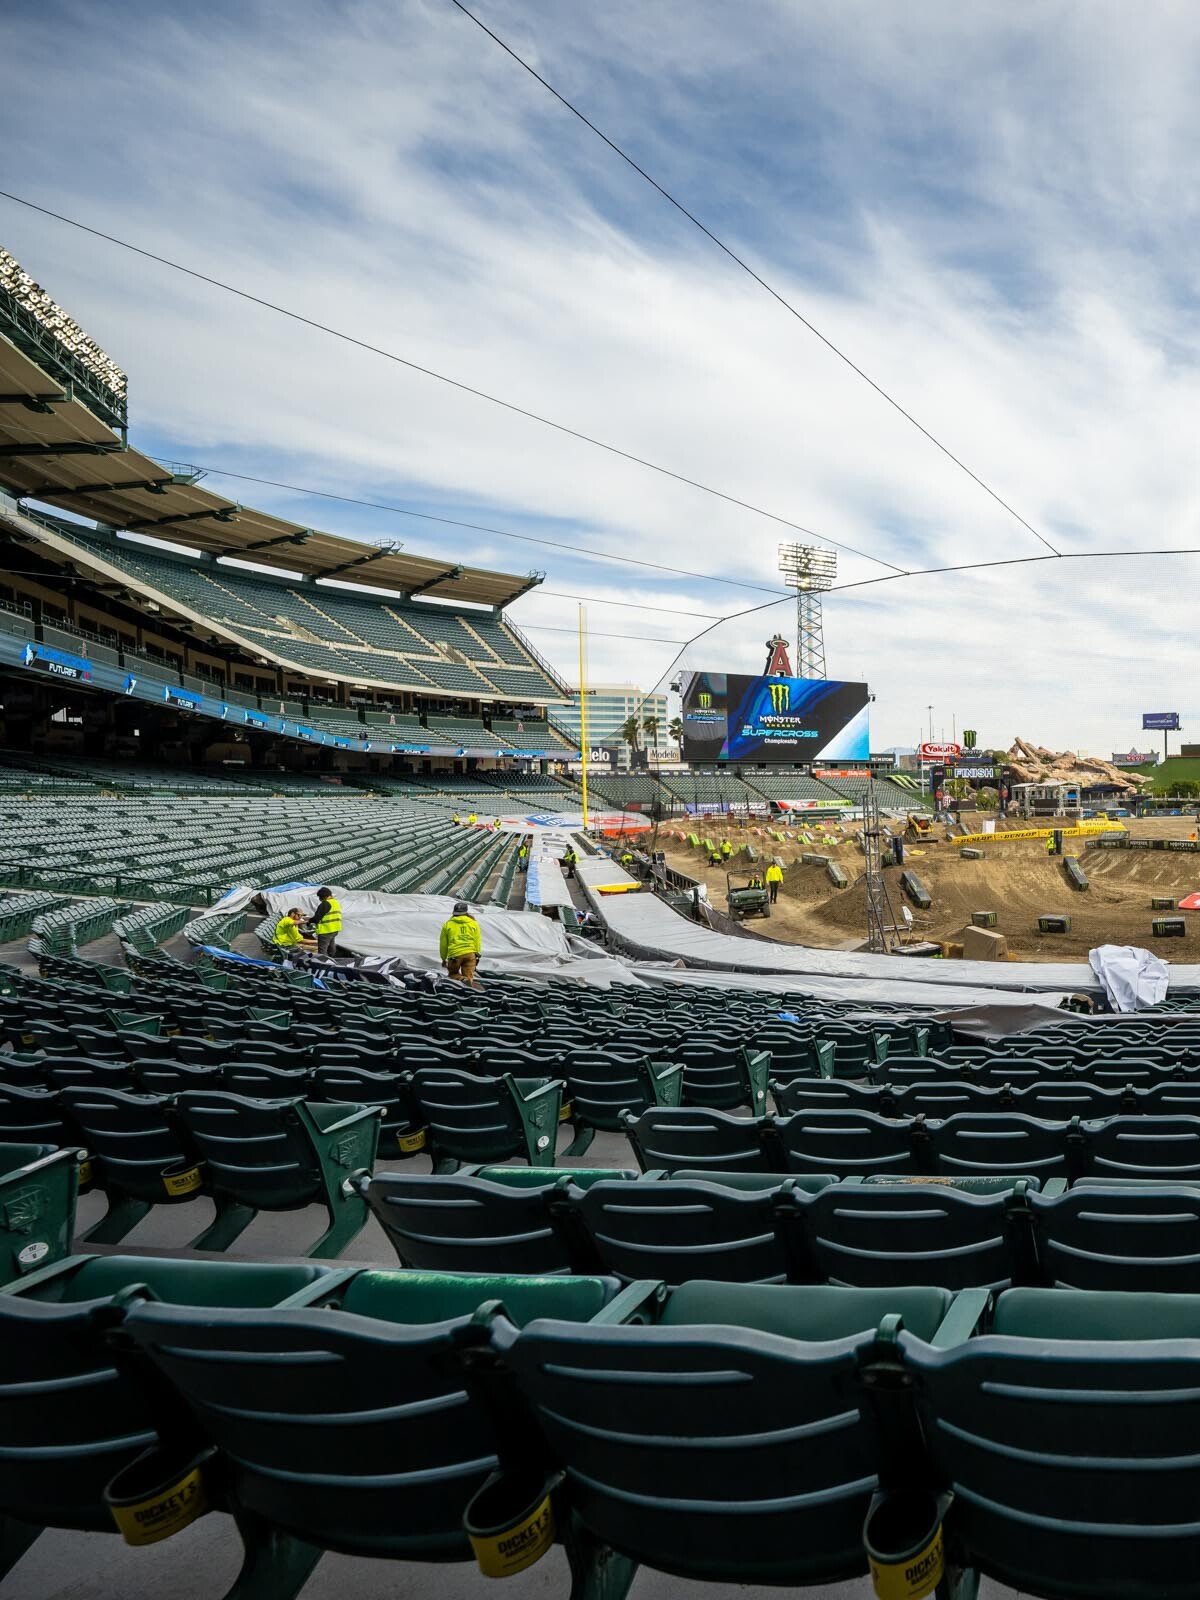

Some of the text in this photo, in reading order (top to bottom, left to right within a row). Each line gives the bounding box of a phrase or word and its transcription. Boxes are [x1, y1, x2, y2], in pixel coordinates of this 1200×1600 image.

[760, 715, 801, 724] MONSTER
[741, 729, 818, 738] SUPERCROSS
[651, 749, 677, 759] Modelo
[954, 767, 994, 778] FINISH
[960, 835, 993, 843] DUNLOP
[1003, 831, 1038, 839] DUNLOP
